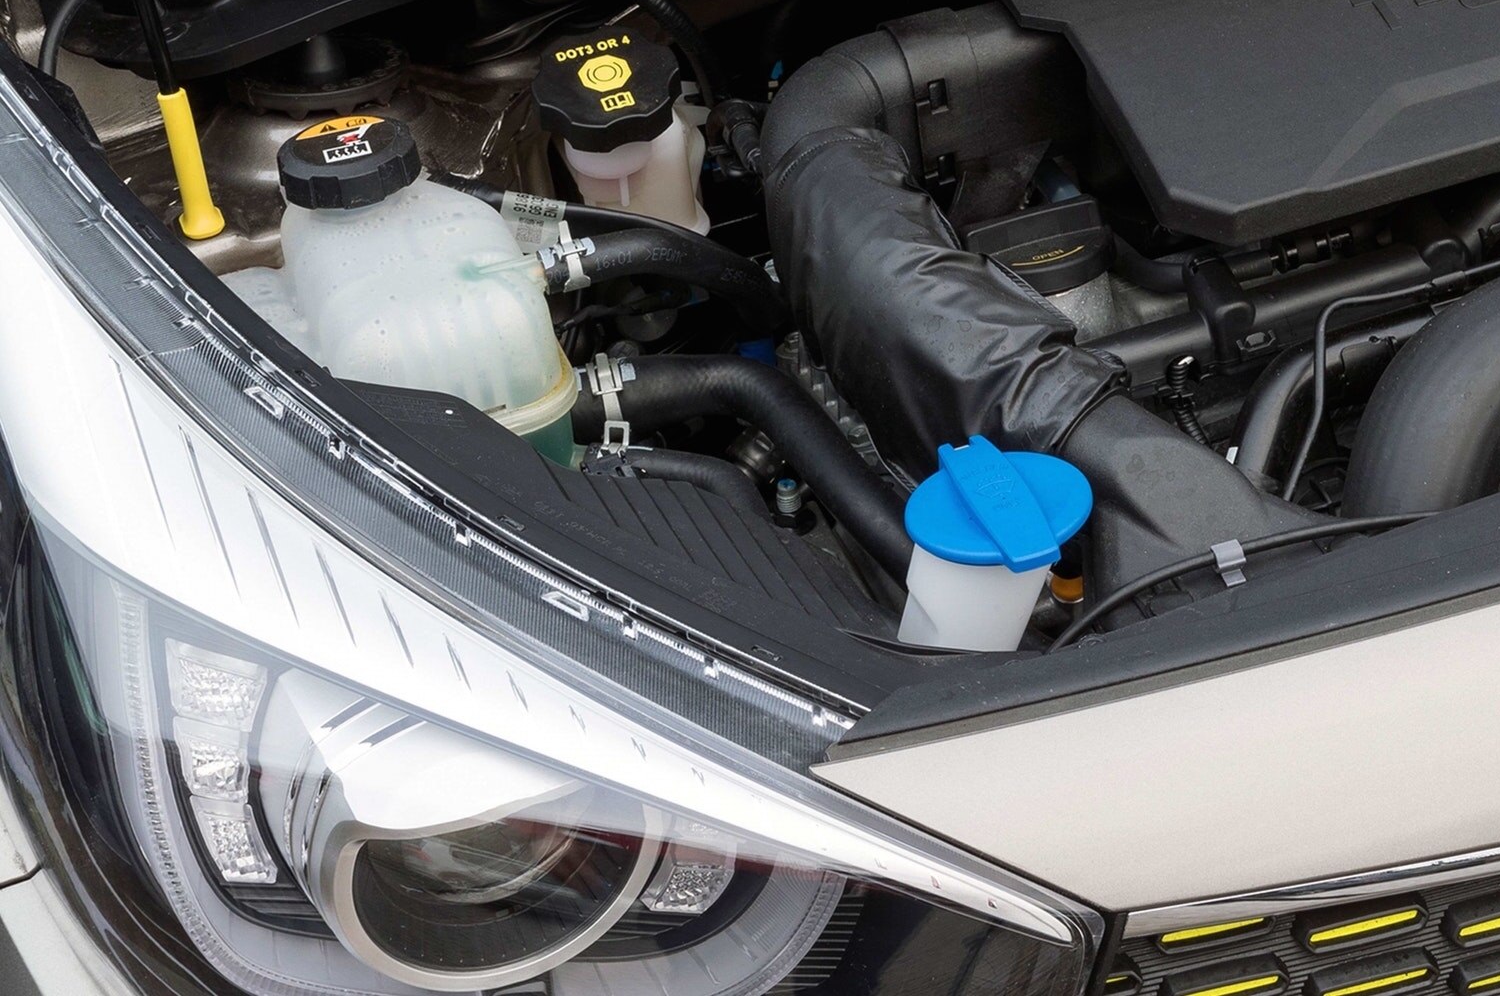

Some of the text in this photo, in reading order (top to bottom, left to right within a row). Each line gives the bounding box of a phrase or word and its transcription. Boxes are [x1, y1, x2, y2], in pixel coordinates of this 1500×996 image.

[555, 35, 631, 62] DOT3 OR 4
[1032, 248, 1065, 261] OPEN
